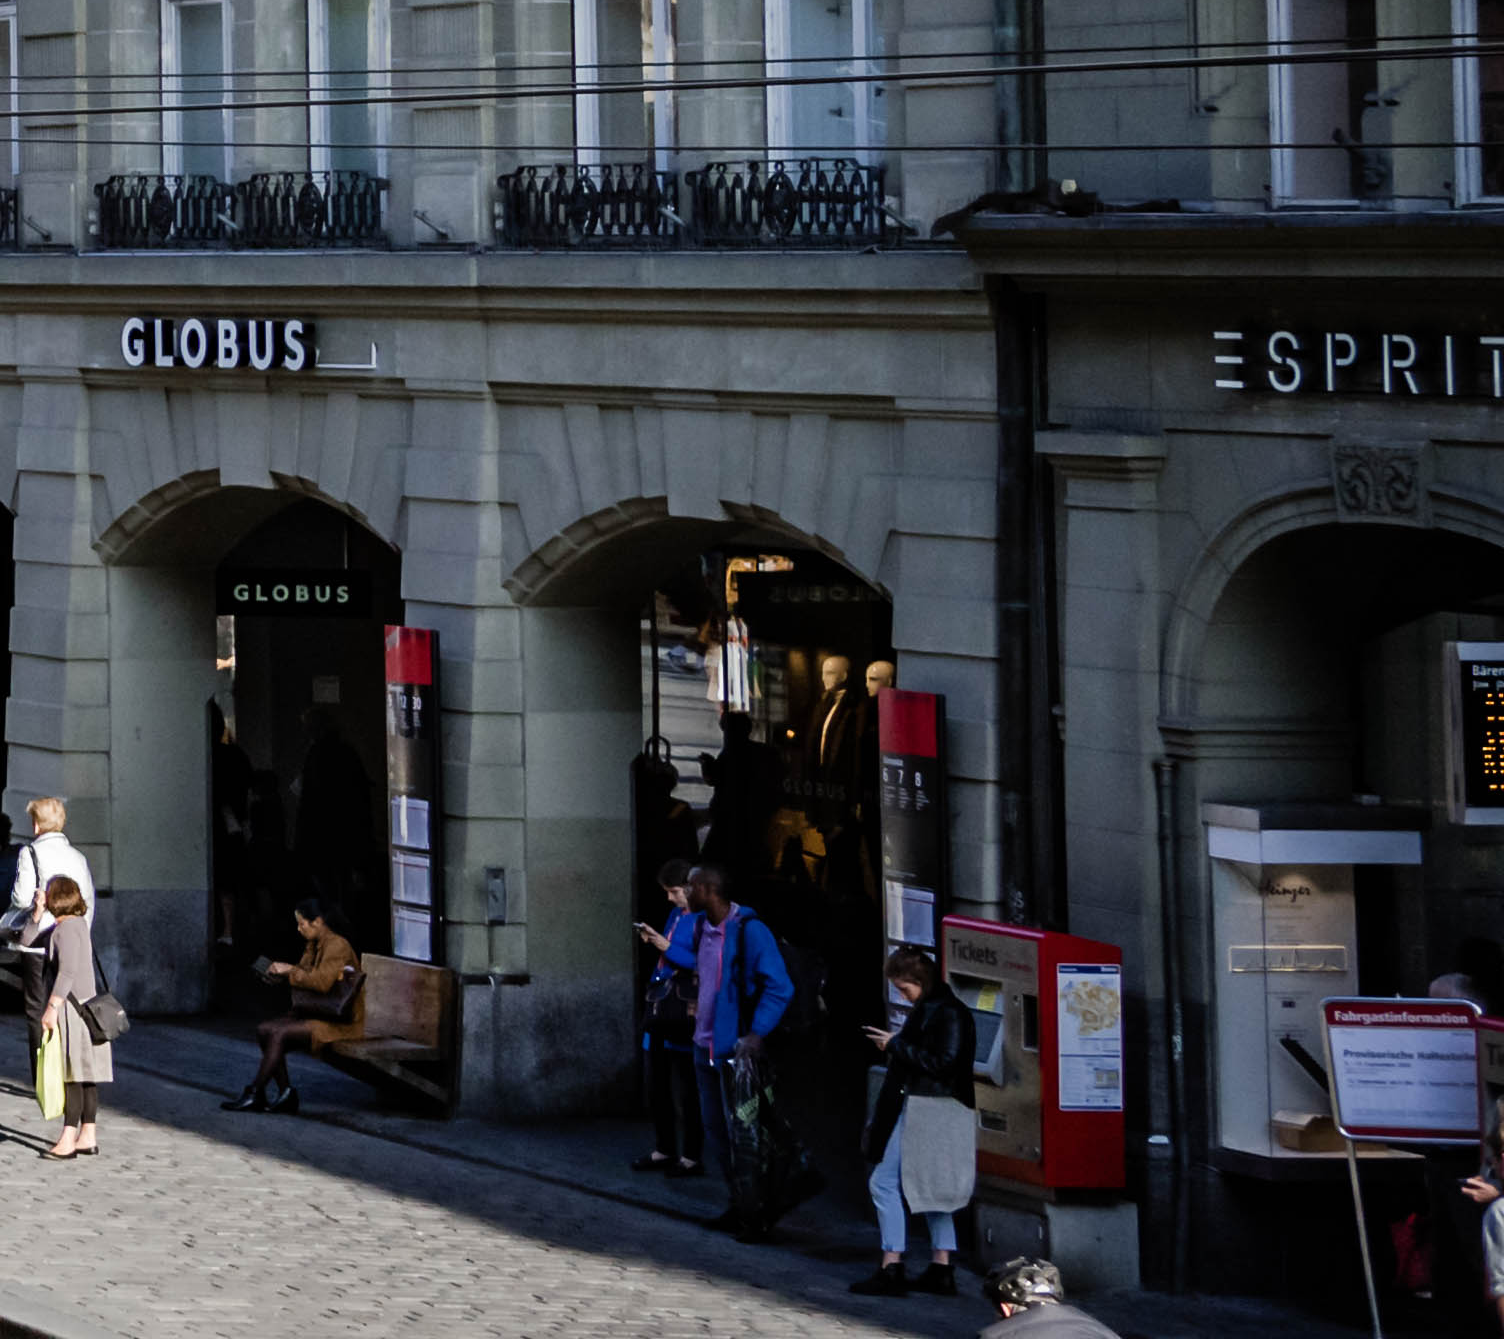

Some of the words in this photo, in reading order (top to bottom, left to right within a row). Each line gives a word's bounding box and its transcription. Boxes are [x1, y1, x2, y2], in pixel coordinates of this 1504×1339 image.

[121, 317, 306, 372] GLOBUS
[1213, 330, 1504, 399] ESPRIT
[232, 583, 350, 604] GLOBUS
[950, 938, 999, 966] Tickets
[1334, 1010, 1470, 1026] Fahrgastinformation
